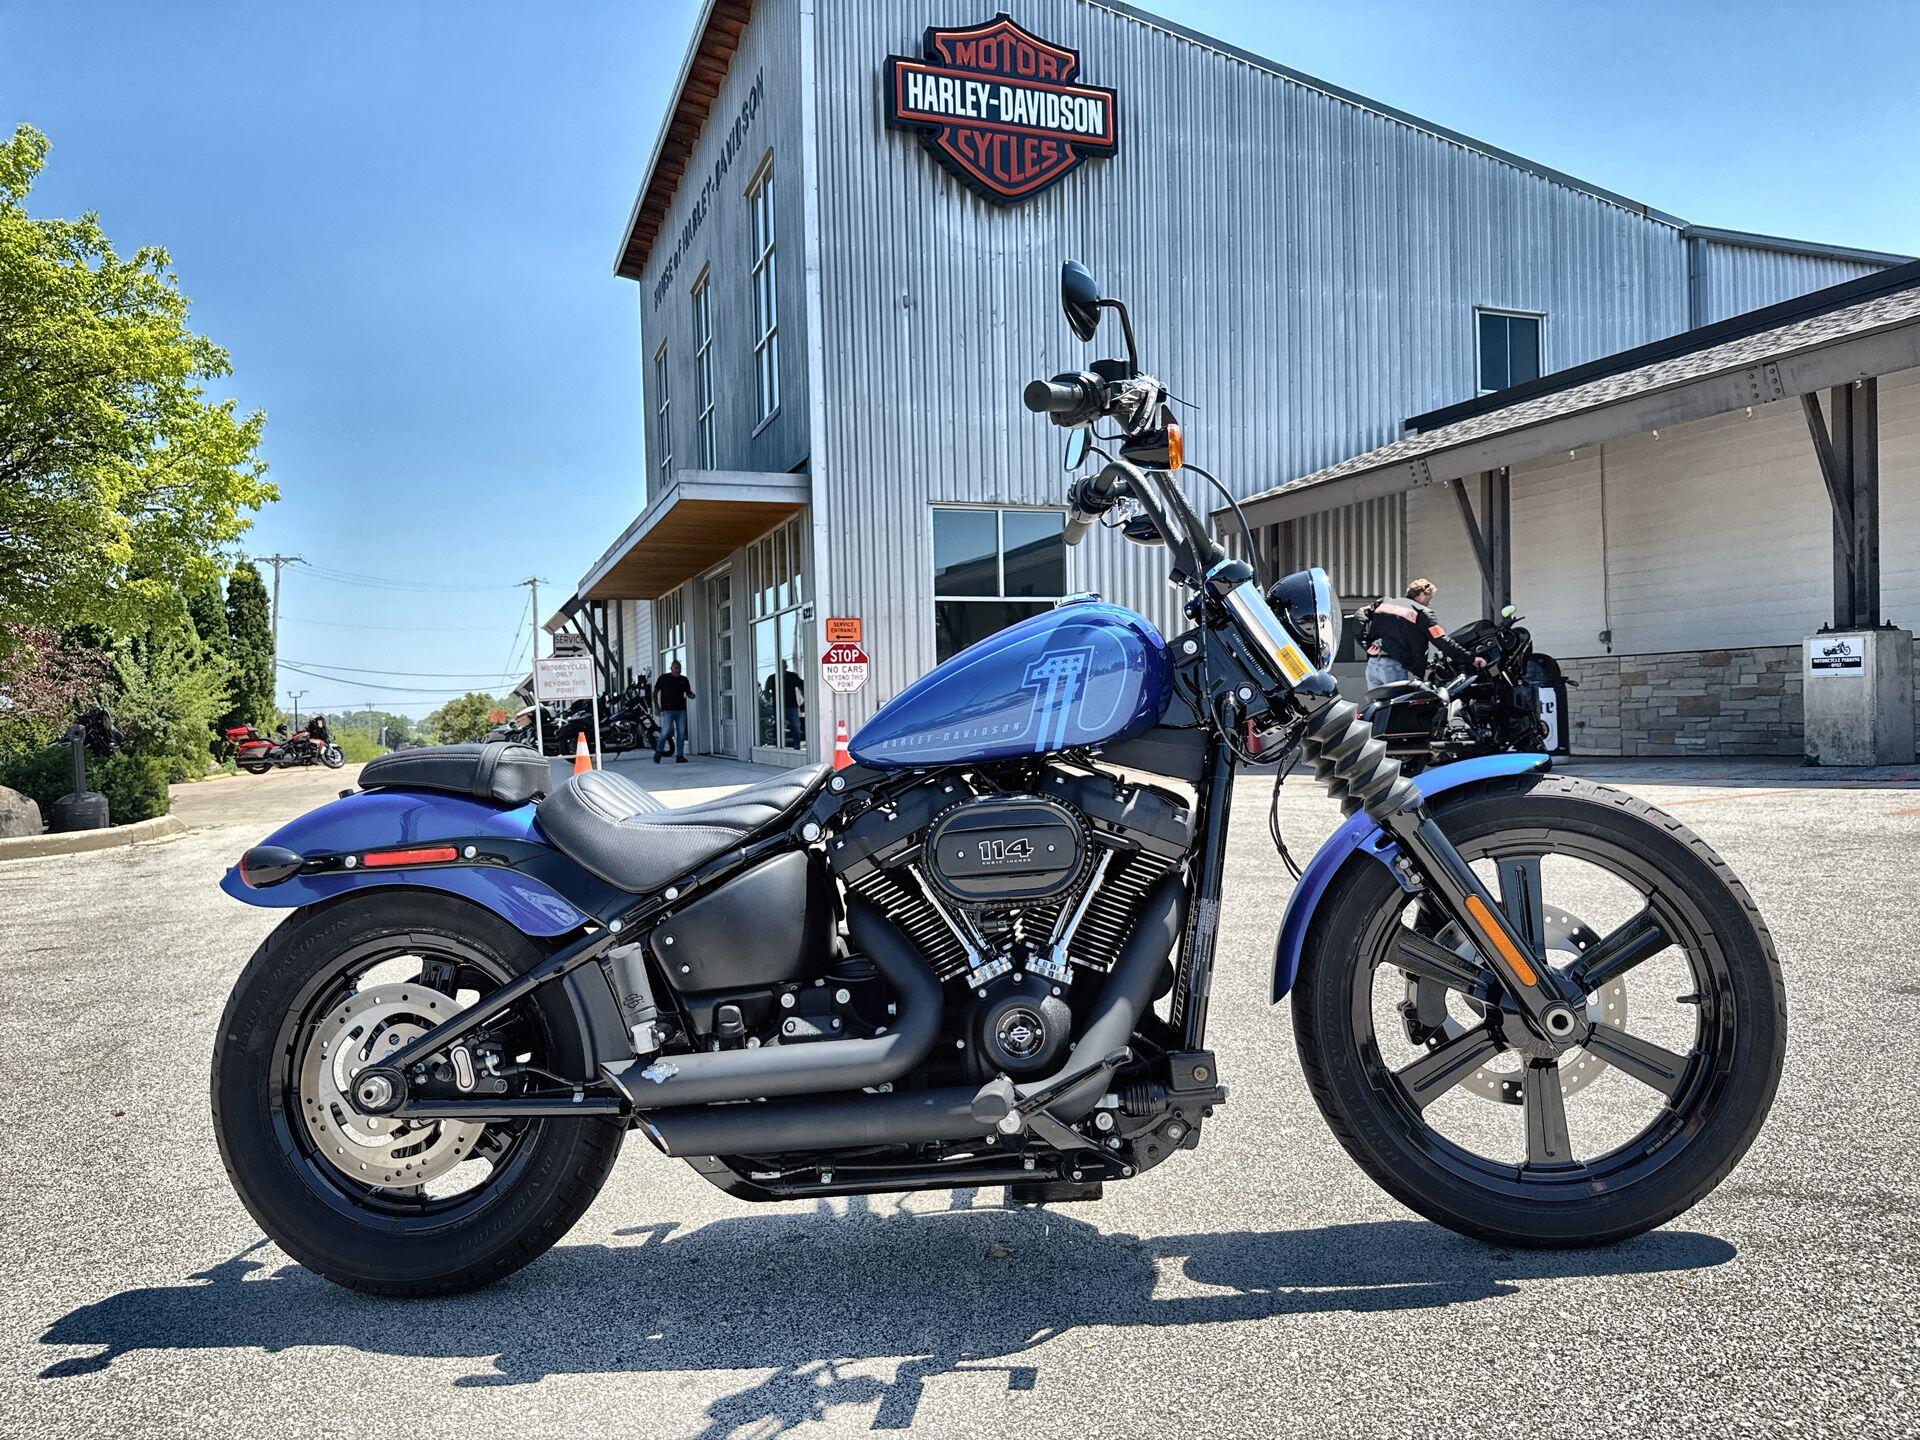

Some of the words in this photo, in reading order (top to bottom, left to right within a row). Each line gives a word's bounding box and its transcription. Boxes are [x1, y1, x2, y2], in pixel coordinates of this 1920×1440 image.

[956, 33, 1058, 80] MOTOR
[908, 73, 1103, 135] HARLEY-DAVIDSON
[682, 66, 764, 253] HARLEY-DAVIDSON
[957, 129, 1059, 183] CYCLES
[555, 635, 585, 644] SERVICE
[541, 663, 587, 671] MOTORCYCLES
[830, 649, 859, 662] STOP
[882, 721, 1022, 749] HARLEY-DAVIDSON
[978, 838, 1034, 860] 114
